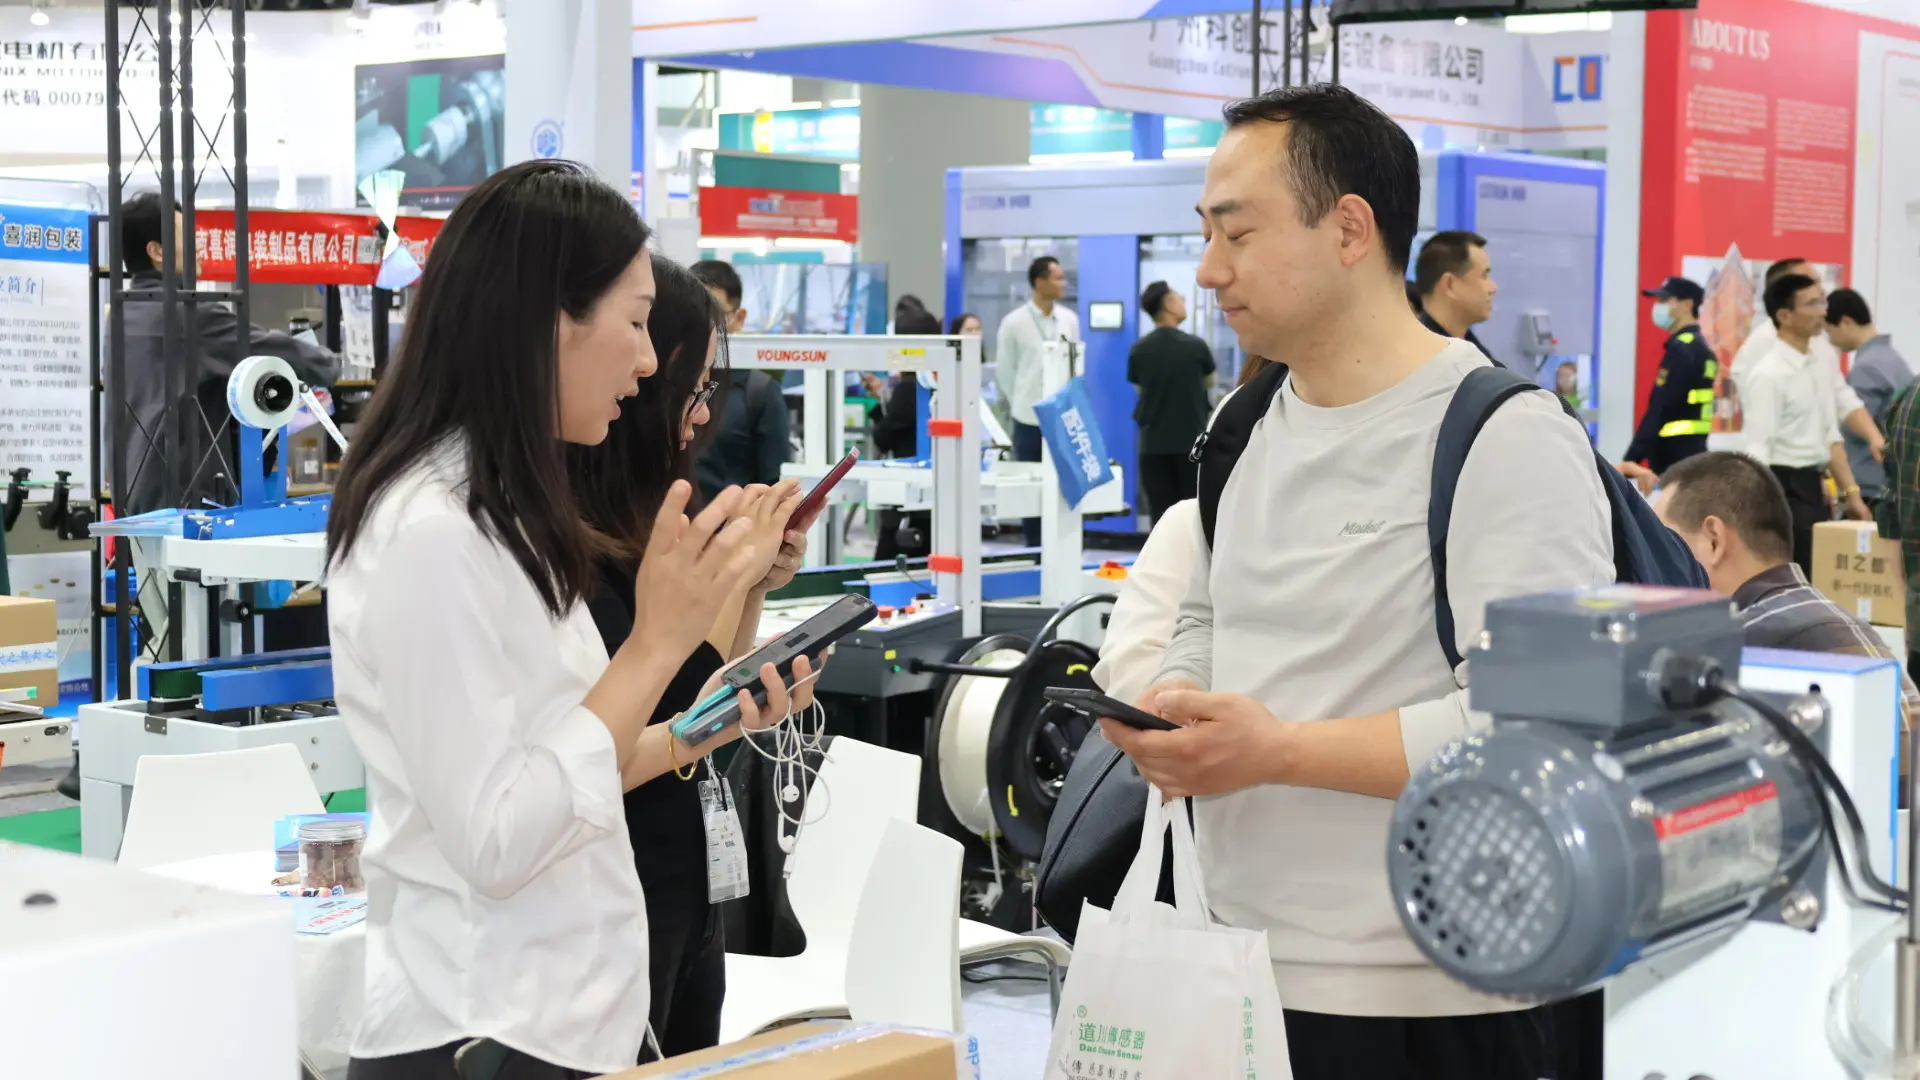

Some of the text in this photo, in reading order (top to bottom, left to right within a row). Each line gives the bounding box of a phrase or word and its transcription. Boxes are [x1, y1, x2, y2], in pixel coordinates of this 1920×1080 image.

[1691, 18, 1770, 61] ABOUT US
[4, 223, 82, 252] 喜润包装
[195, 228, 355, 265] 南喜润装制品有限公司
[756, 349, 828, 362] YOUNGSUN
